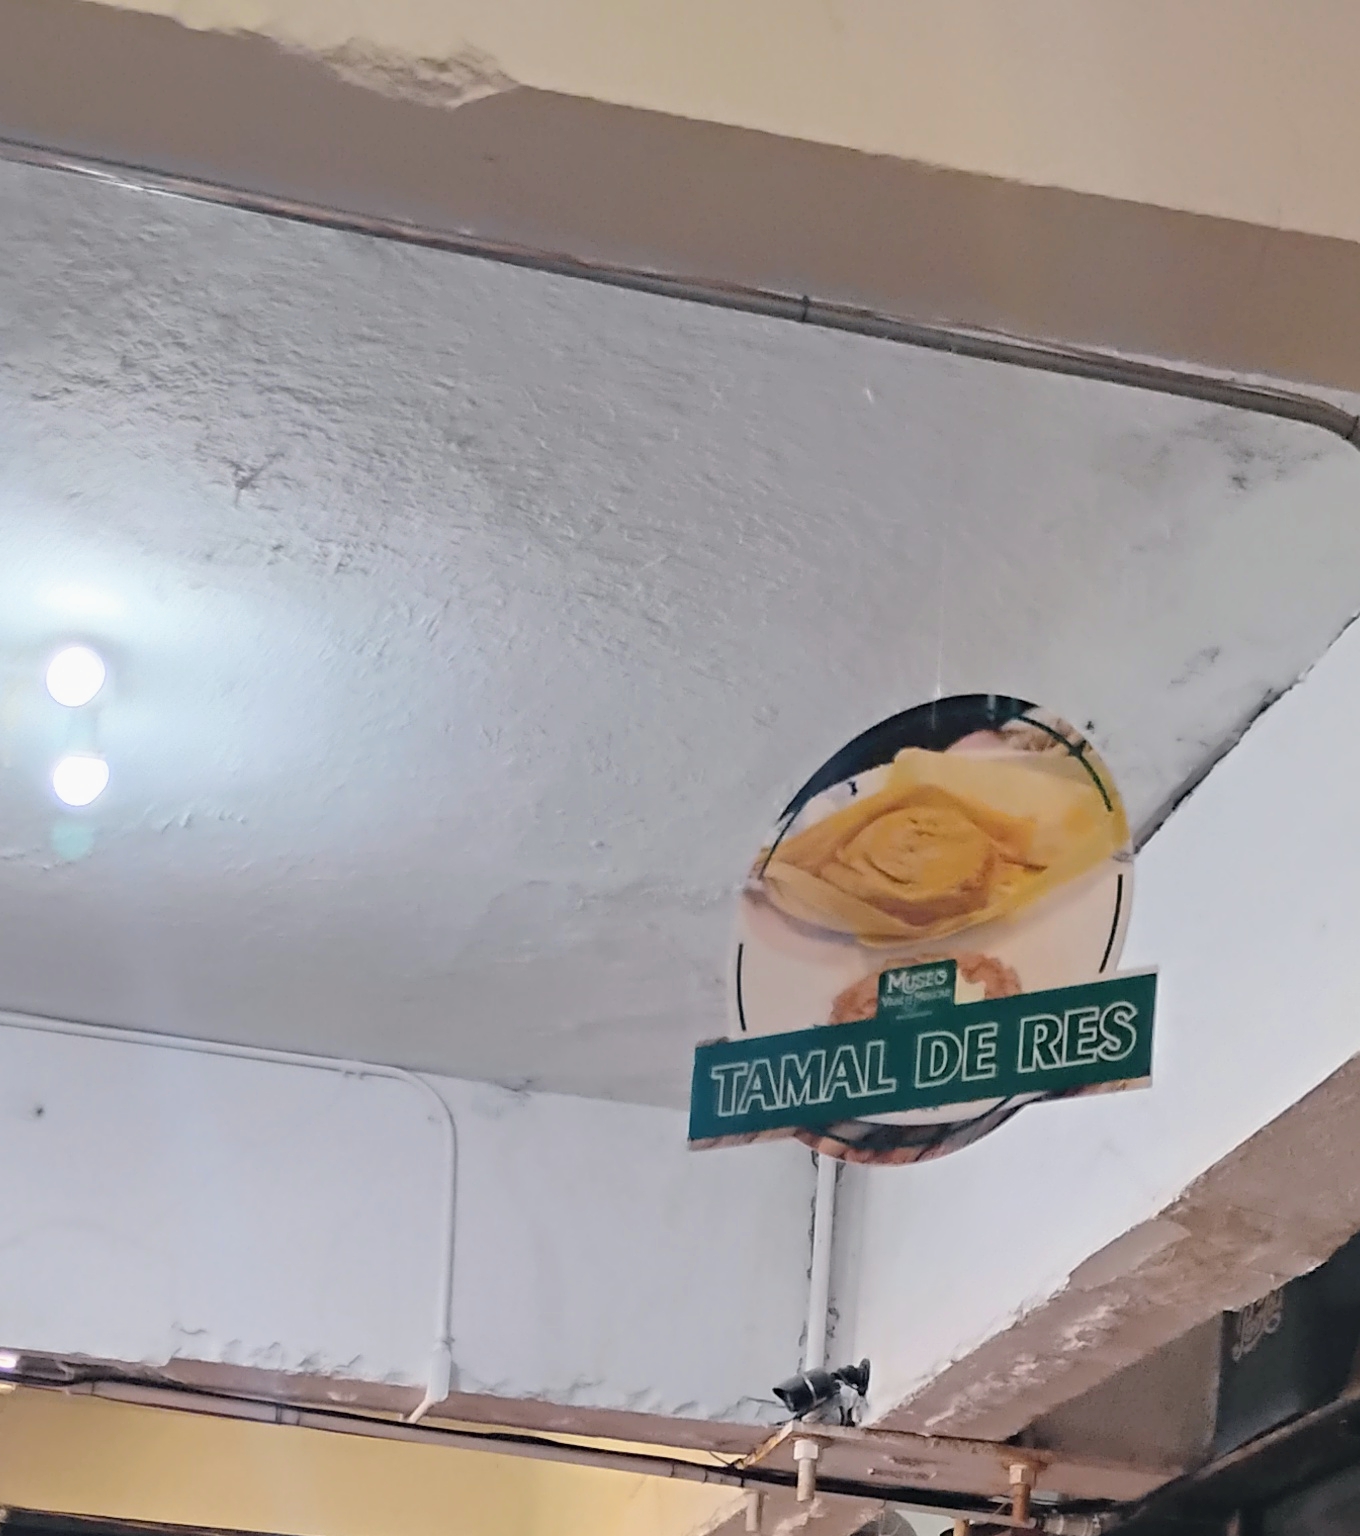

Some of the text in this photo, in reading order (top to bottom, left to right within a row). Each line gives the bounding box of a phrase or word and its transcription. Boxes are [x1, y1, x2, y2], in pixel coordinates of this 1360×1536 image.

[709, 1001, 1138, 1118] TAMAL DE RES
